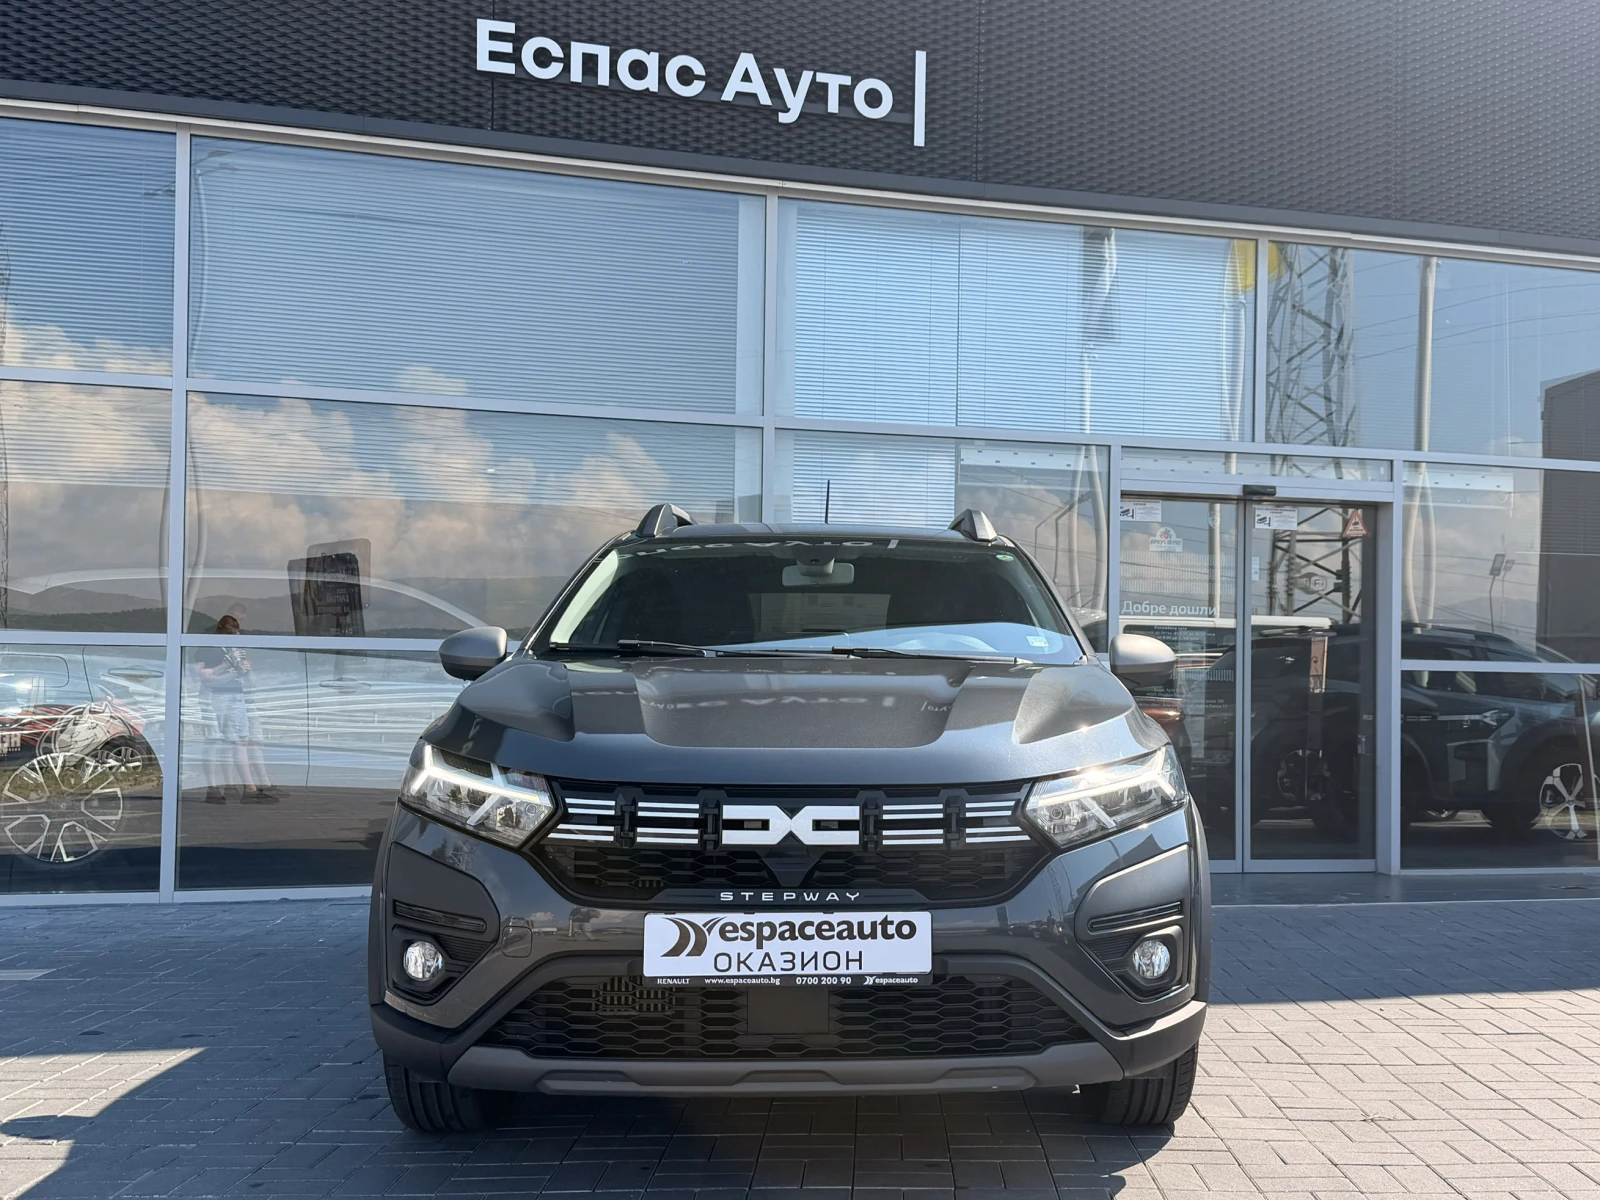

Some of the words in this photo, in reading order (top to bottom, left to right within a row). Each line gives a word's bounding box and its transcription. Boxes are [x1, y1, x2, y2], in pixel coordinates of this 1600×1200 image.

[476, 18, 706, 98] Еспас
[721, 52, 894, 124] Ауто
[1121, 600, 1167, 615] Добре
[1169, 605, 1216, 616] дошли
[719, 892, 861, 902] STEPWAY
[718, 915, 917, 949] espaceauto
[713, 950, 863, 973] ОКАЗИОН
[657, 977, 691, 985] RENAULT
[704, 977, 781, 986] www.espaceauto.bg
[796, 976, 819, 985] 0700
[821, 976, 838, 985] 200
[840, 976, 852, 985] 90
[874, 976, 919, 986] espaceauto
